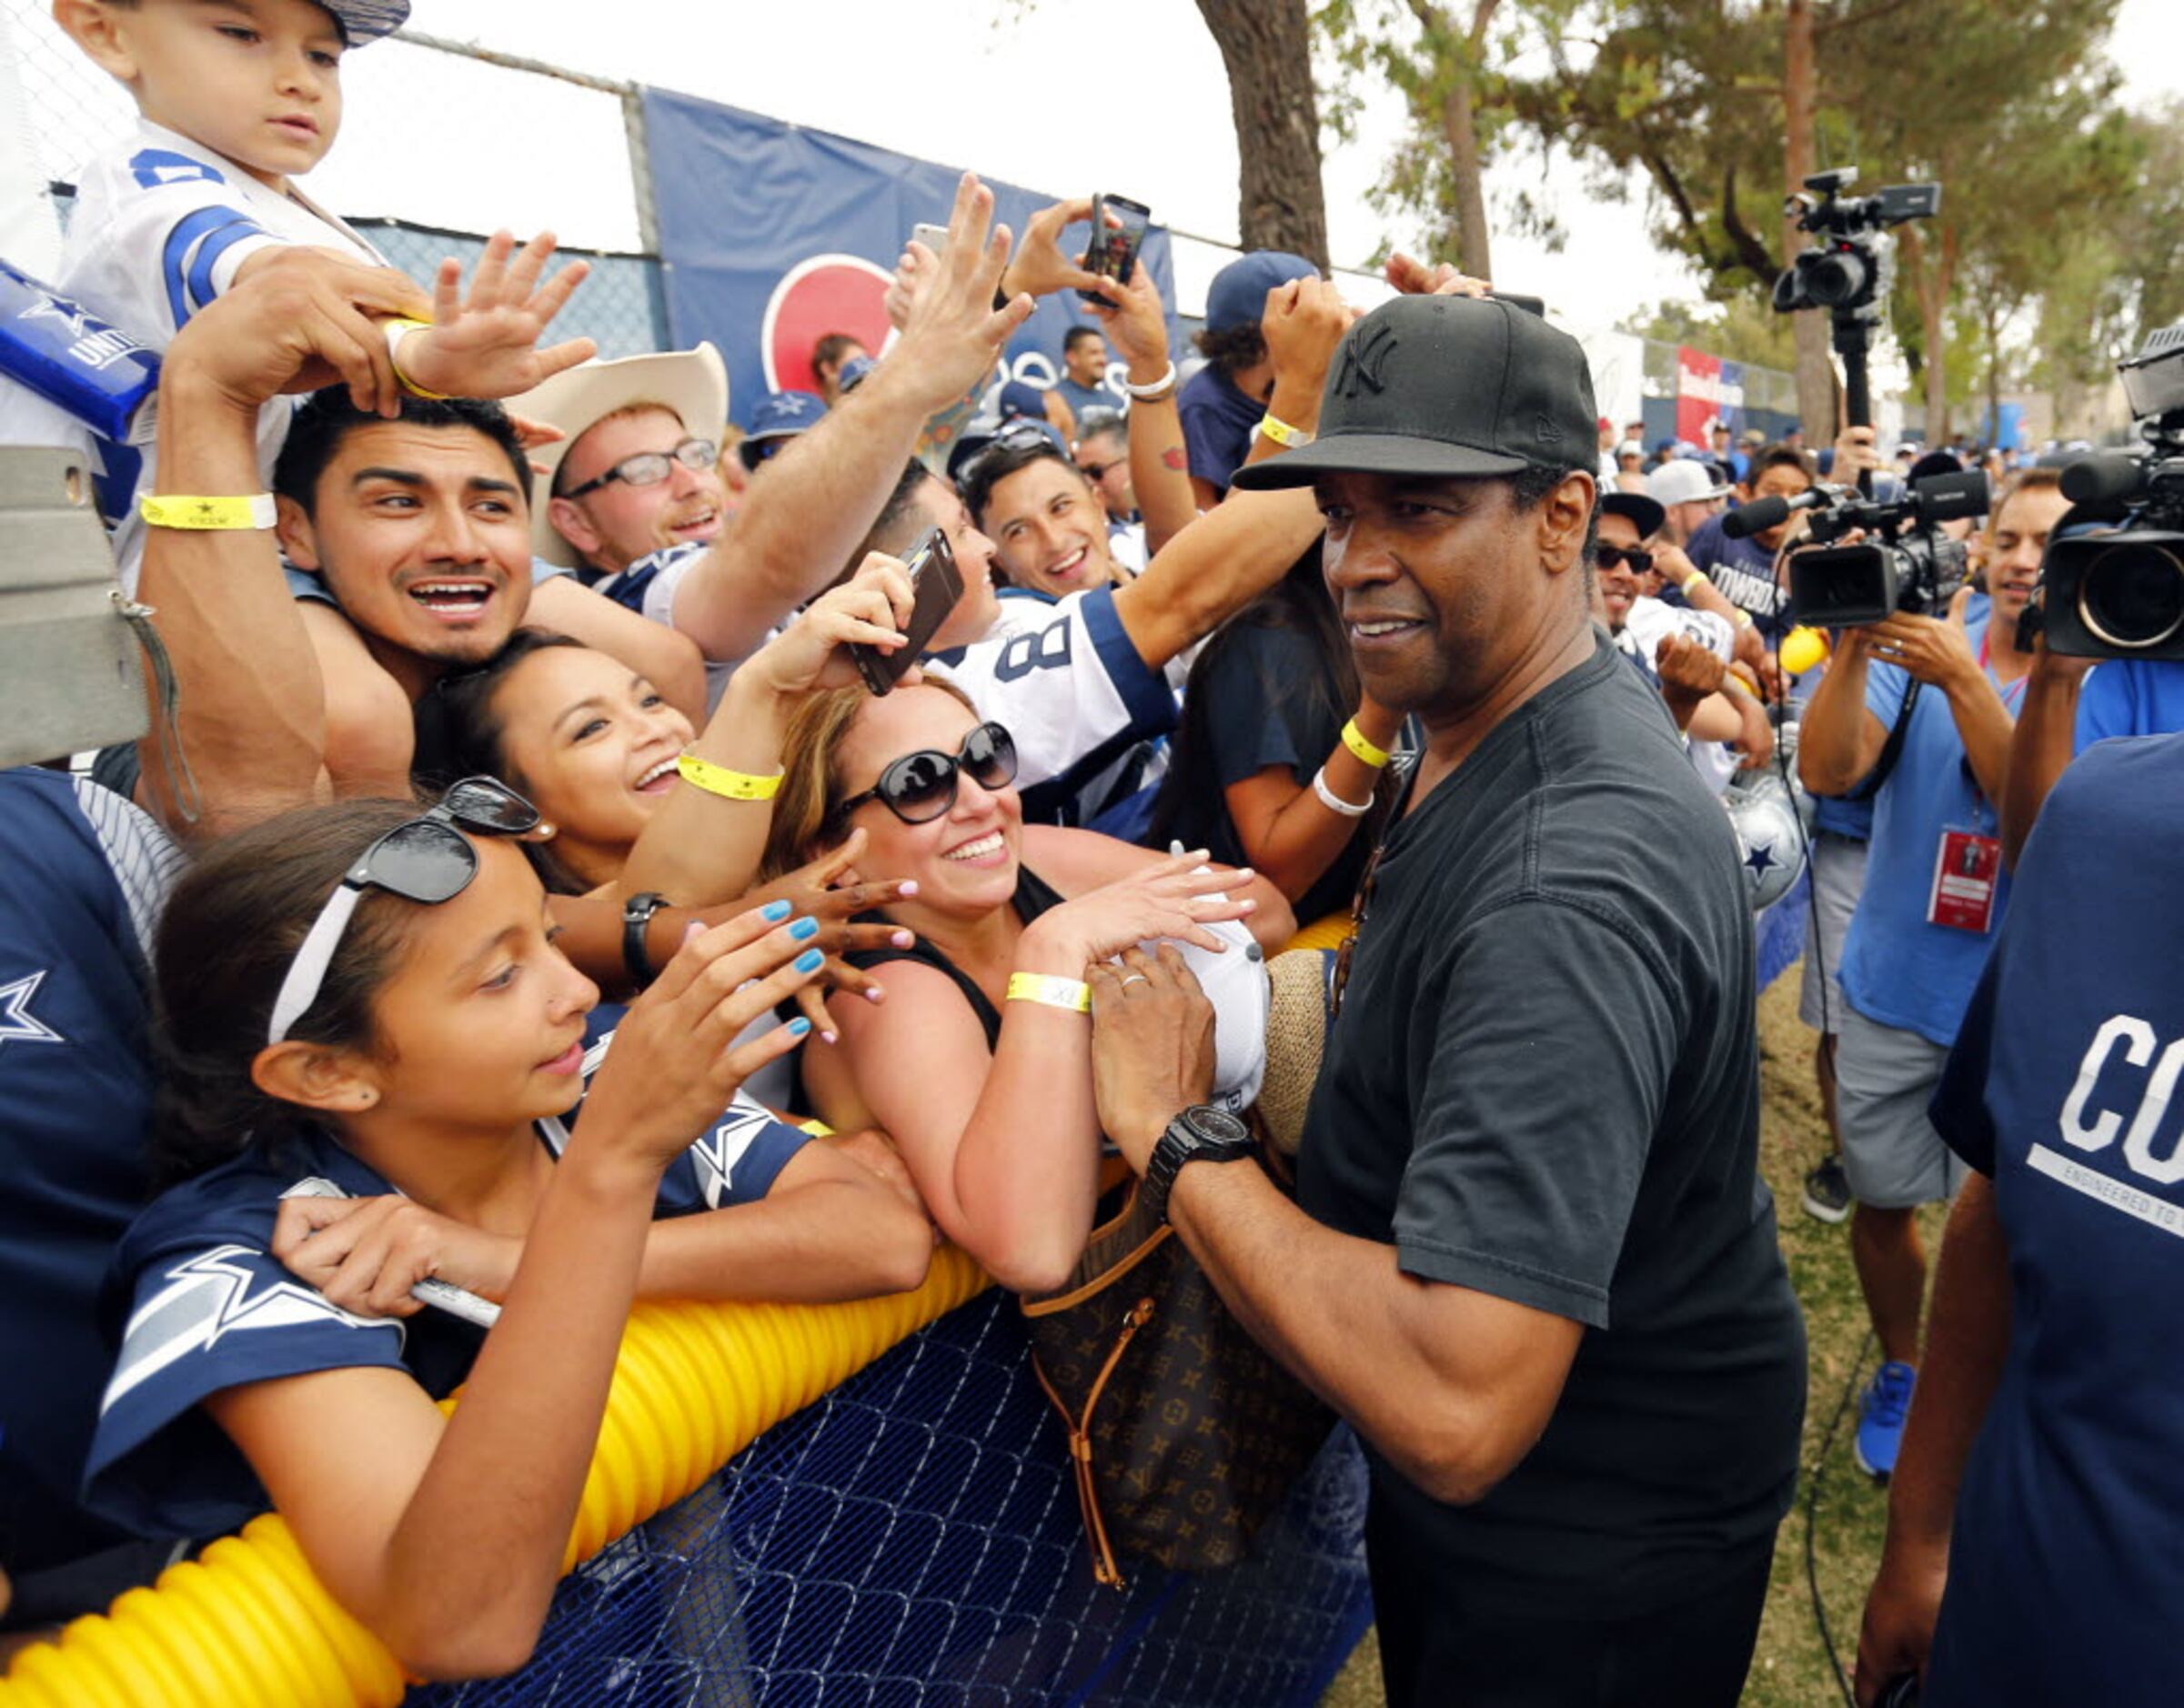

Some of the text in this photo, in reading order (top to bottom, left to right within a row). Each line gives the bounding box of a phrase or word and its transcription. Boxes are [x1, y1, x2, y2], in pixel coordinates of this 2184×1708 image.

[993, 613, 1072, 684] 8
[2062, 1163, 2179, 1226] ENGINEERED TO
